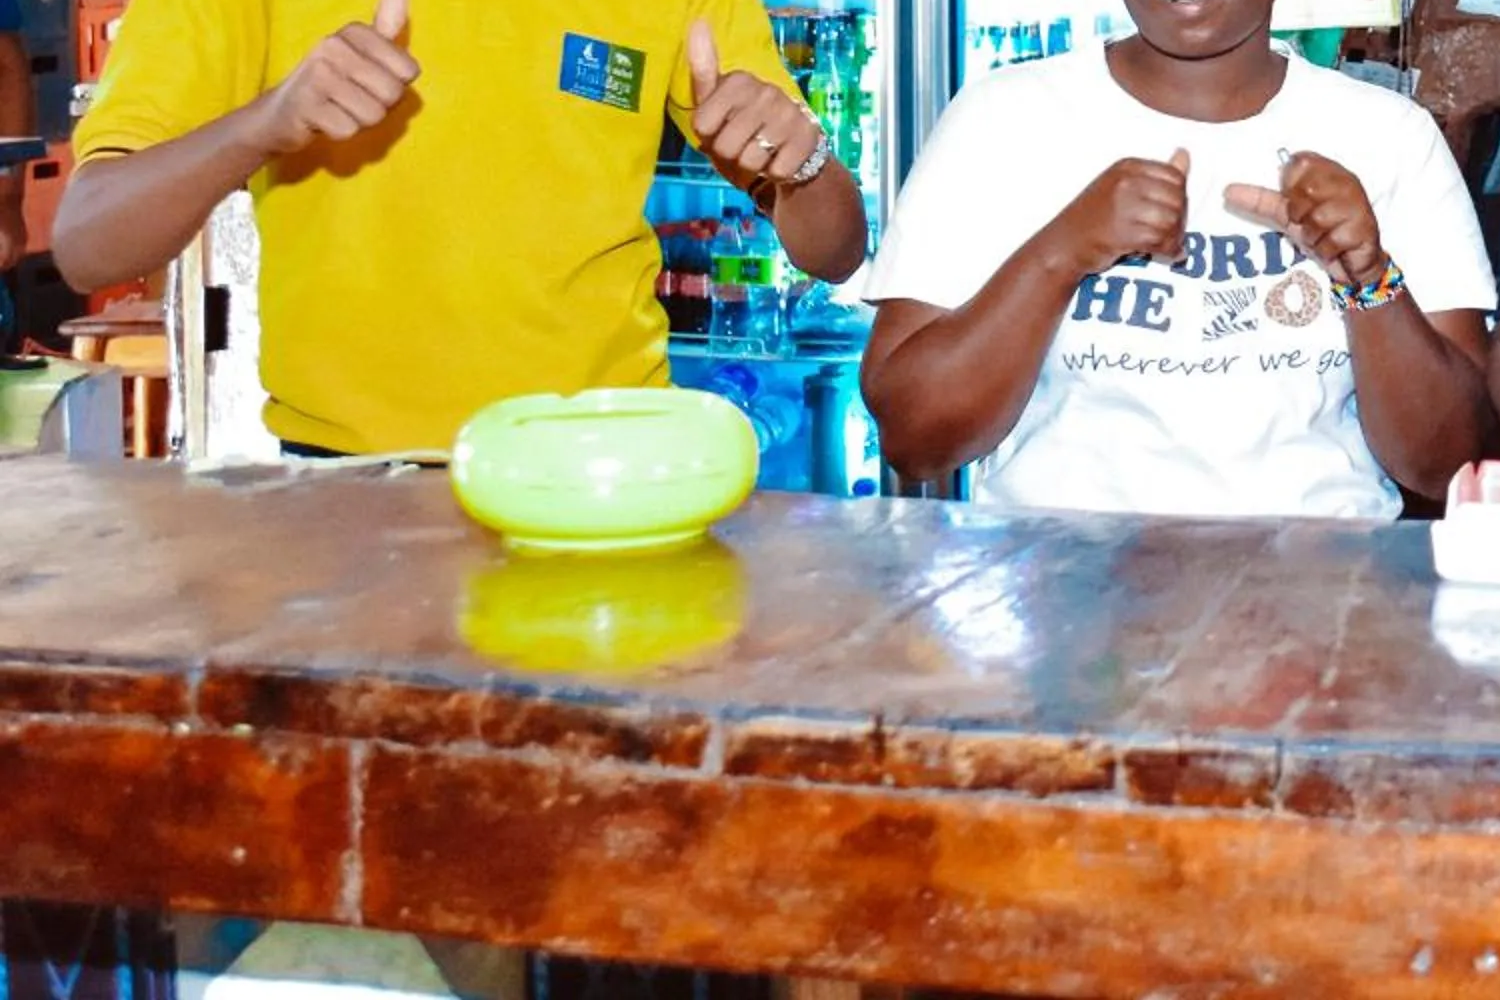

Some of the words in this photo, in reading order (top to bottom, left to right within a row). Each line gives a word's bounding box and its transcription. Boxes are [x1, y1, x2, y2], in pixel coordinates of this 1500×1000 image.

[1171, 231, 1306, 281] BRI
[1071, 273, 1175, 333] HE
[1062, 343, 1241, 375] wherever
[1259, 348, 1310, 372] we
[1316, 348, 1352, 375] go
